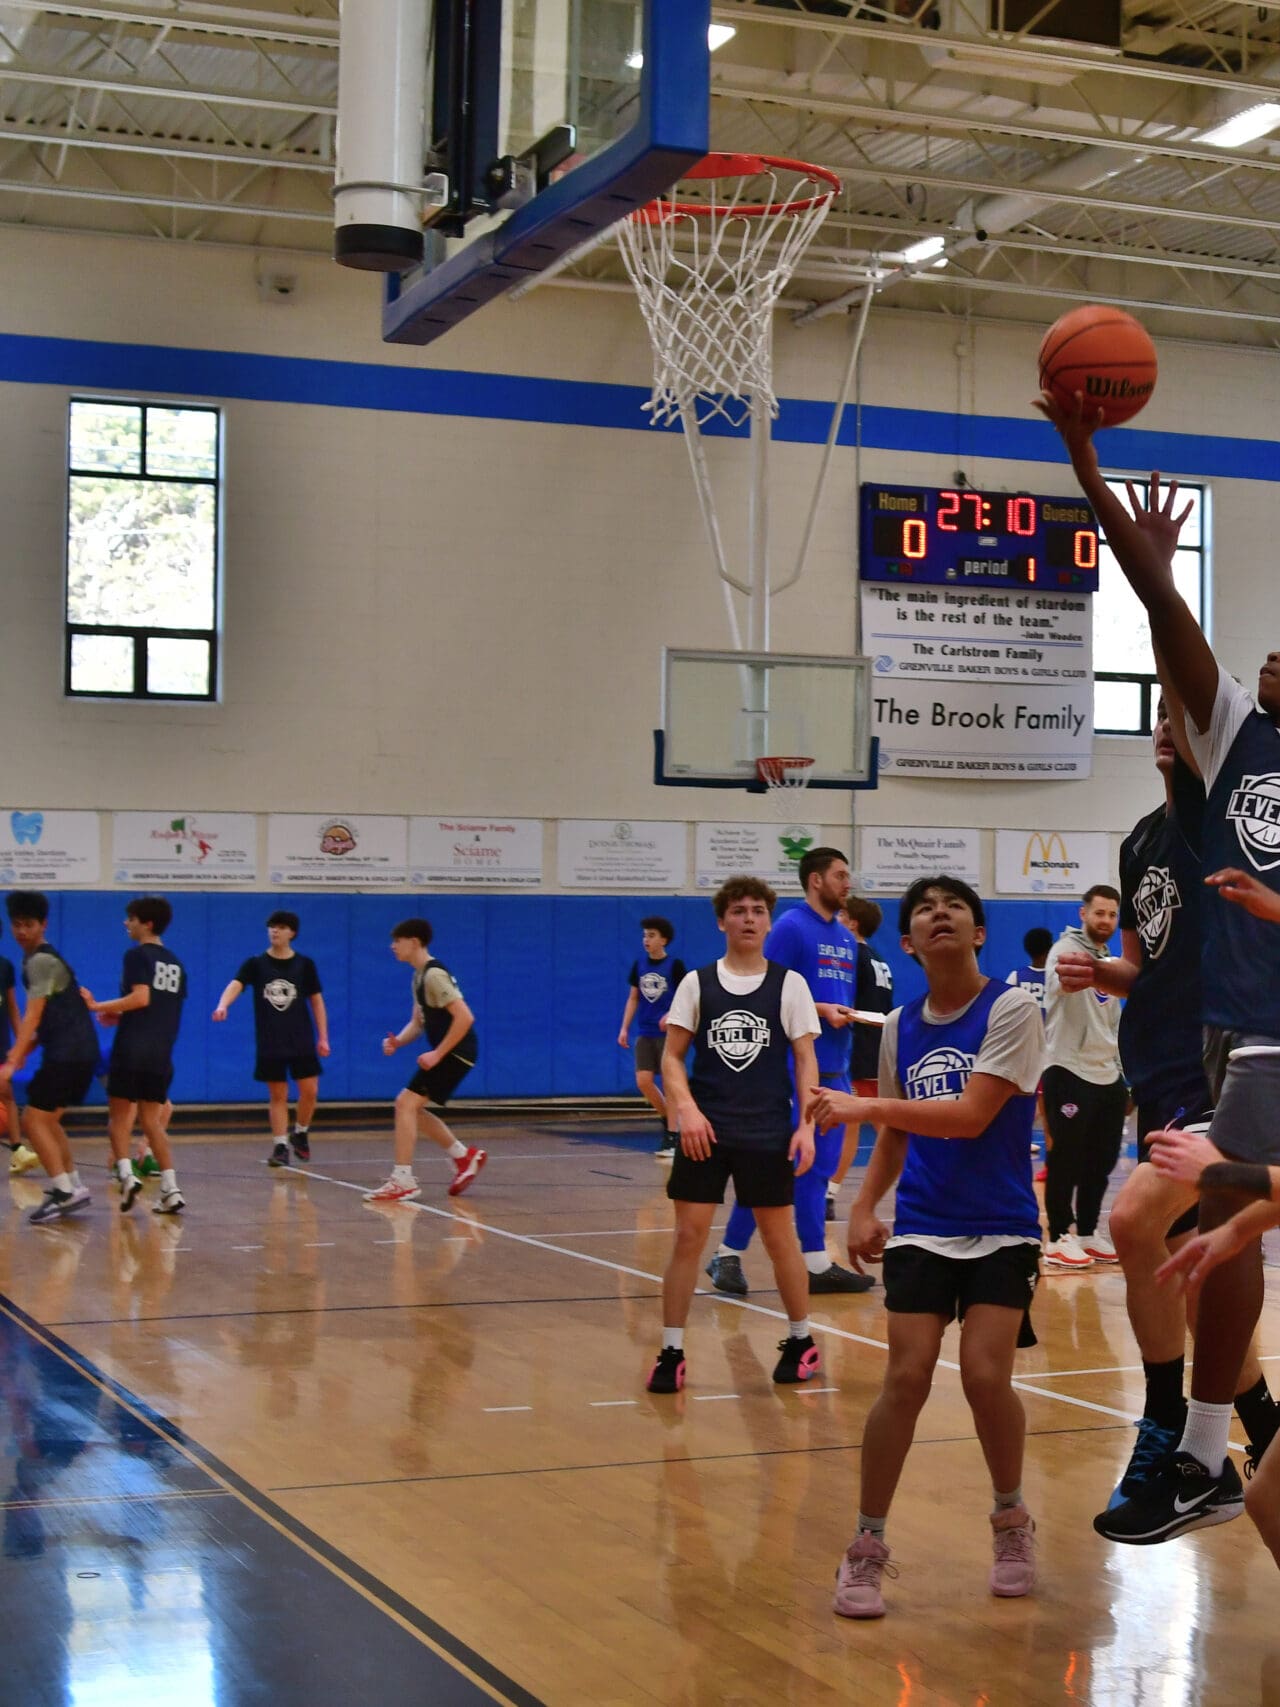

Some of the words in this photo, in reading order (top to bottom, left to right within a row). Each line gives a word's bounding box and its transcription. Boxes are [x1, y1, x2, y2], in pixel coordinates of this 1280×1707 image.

[1086, 375, 1154, 398] Wilson
[879, 492, 917, 511] Home
[938, 492, 1036, 536] 27:10
[1043, 504, 1088, 523] Guests
[903, 519, 926, 558] 0
[1075, 530, 1096, 568] 0
[964, 560, 1008, 576] period
[1028, 558, 1035, 582] 1
[907, 591, 938, 604] main
[945, 592, 1009, 608] ingredient
[1016, 596, 1029, 609] of
[1036, 599, 1085, 612] stardom
[897, 608, 907, 621] is
[915, 609, 935, 622] the
[942, 612, 966, 624] rest
[973, 612, 986, 625] of
[994, 613, 1013, 626] the
[913, 643, 934, 655] The
[941, 644, 1000, 658] Carlstrom
[1006, 647, 1043, 662] Family
[899, 662, 954, 673] GRENVILLE
[994, 666, 1019, 675] BOYS
[1031, 668, 1058, 677] GIRLS
[1061, 670, 1087, 678] CLUB
[874, 697, 920, 725] The
[932, 702, 1005, 729] Brook
[1015, 704, 1086, 737] Family
[439, 823, 454, 831] The
[489, 825, 515, 833] Family
[877, 838, 894, 848] The
[937, 838, 966, 849] Family
[1030, 860, 1080, 869] McDonald's
[153, 961, 180, 993] 88
[709, 1028, 747, 1046] LEVEL
[751, 1028, 768, 1044] UP
[906, 1073, 953, 1101] LEVEL
